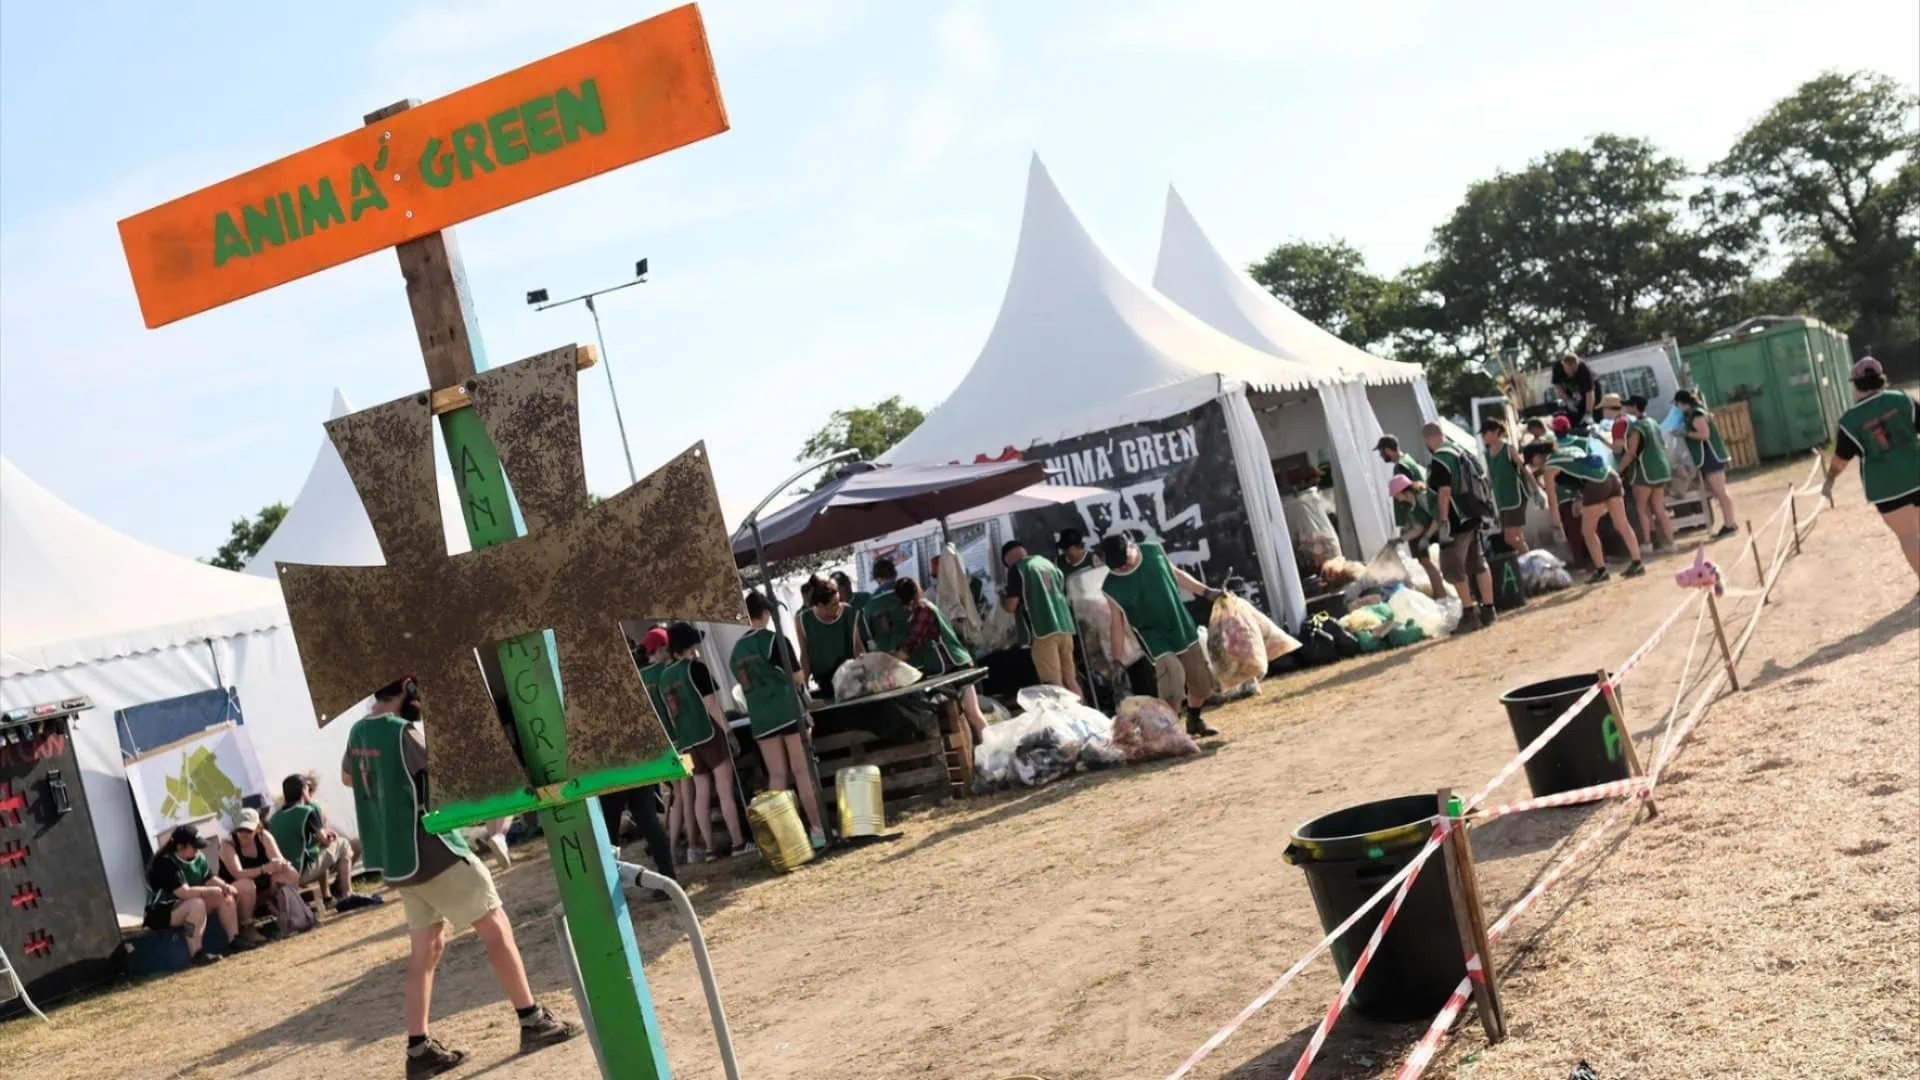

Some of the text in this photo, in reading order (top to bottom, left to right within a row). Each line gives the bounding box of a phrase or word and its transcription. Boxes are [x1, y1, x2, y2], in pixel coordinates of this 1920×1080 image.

[418, 78, 607, 189] GREEN
[1043, 423, 1200, 487] NIMA' GREEN
[1501, 561, 1520, 595] A
